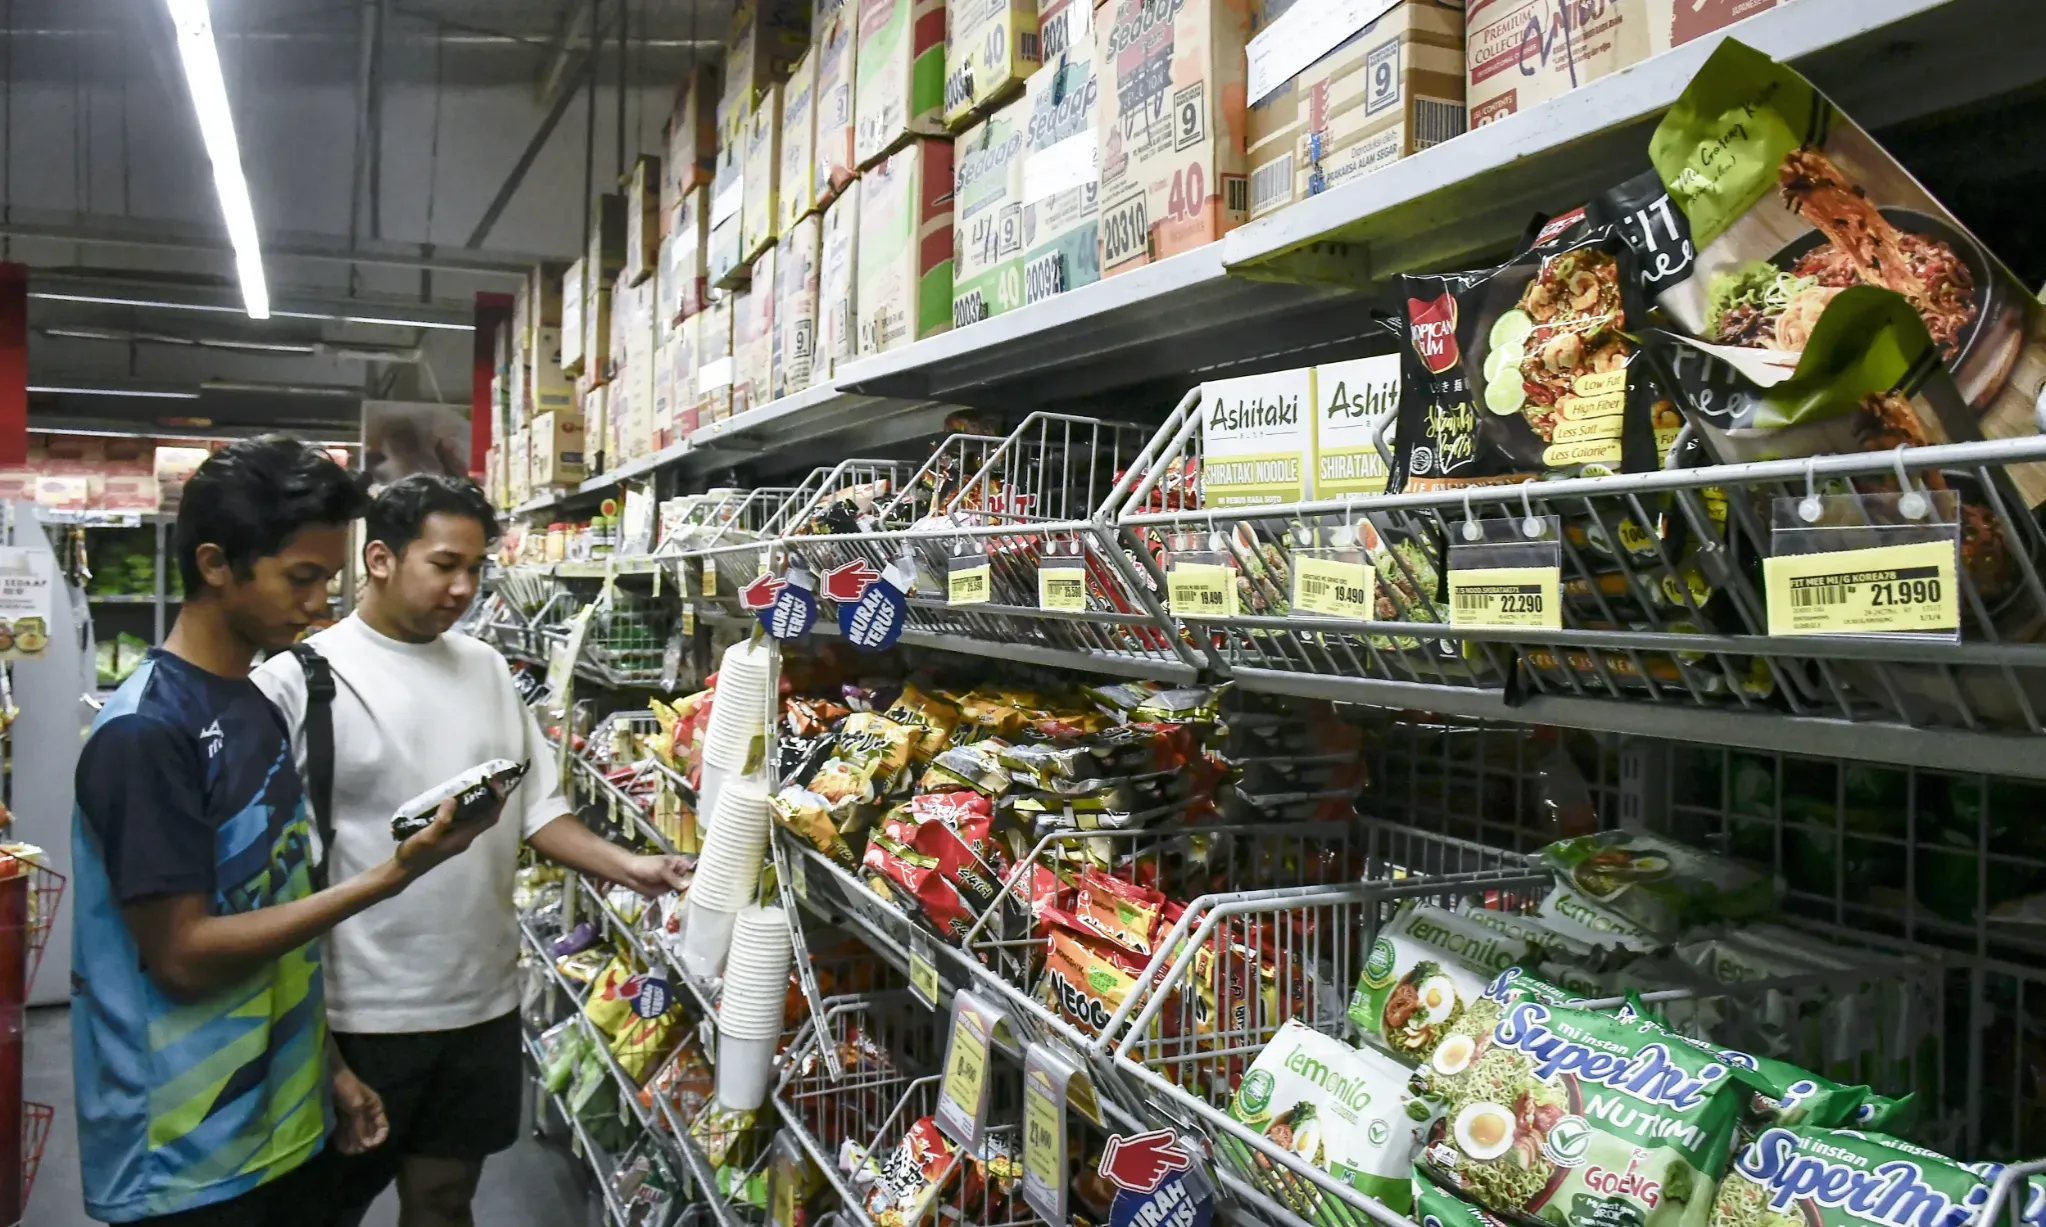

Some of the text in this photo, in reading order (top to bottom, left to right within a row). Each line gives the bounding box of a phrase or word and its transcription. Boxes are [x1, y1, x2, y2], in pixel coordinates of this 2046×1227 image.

[1484, 10, 1532, 44] PREMIUM
[984, 23, 1005, 70] 40
[1475, 27, 1536, 63] COLLECTI
[1375, 62, 1392, 97] 9
[1182, 103, 1196, 135] 9
[1168, 161, 1204, 223] 40
[1004, 218, 1014, 243] 9
[1104, 201, 1146, 260] 20310
[997, 266, 1020, 310] 40
[796, 330, 804, 350] 9
[1584, 375, 1622, 391] Low Fat
[1210, 394, 1299, 431] Ashitaki
[1572, 399, 1620, 416] High Fiber
[1557, 423, 1598, 439] Less Salt
[1205, 458, 1299, 486] SHIRATAKI NOODLE
[1320, 453, 1383, 481] SHIRATAKI
[1551, 450, 1569, 461] Less
[1335, 586, 1364, 604] 19.490
[1806, 577, 1825, 587] MEE
[1852, 571, 1897, 584] KOREA78
[1871, 579, 1942, 606] 21.990
[1200, 591, 1223, 604] 19.490
[1501, 595, 1543, 613] 22.290
[773, 592, 795, 639] MURAH
[785, 597, 807, 638] TERUS!
[848, 588, 885, 646] MURAH
[862, 597, 896, 648] TERUS!
[1405, 915, 1517, 972] lemonilo
[641, 984, 653, 1017] MURAH
[1557, 1021, 1579, 1039] mi
[1580, 1031, 1629, 1055] instan
[1494, 1003, 1729, 1112] SuperMi
[1284, 1044, 1372, 1112] lemonilo
[1811, 1140, 1868, 1168] instan
